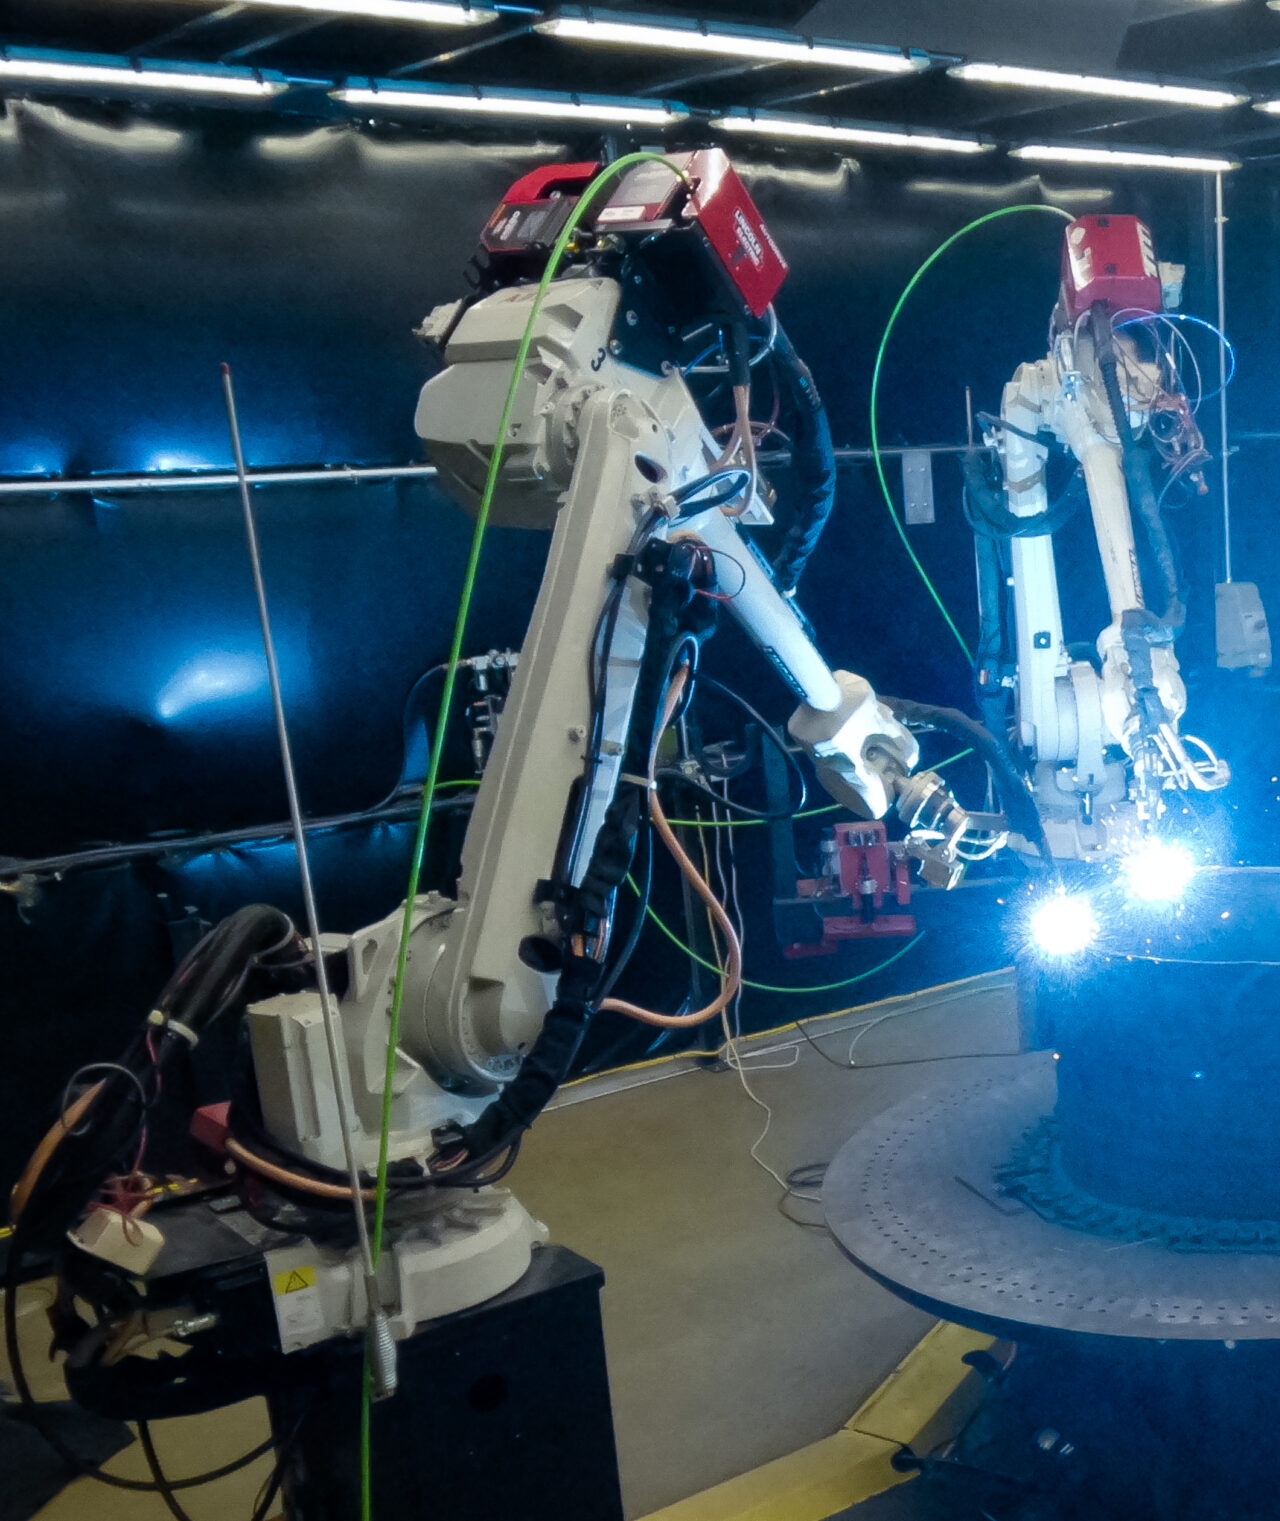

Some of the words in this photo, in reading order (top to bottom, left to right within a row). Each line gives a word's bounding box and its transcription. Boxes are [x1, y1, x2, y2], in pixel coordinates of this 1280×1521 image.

[734, 209, 761, 255] LINCOLN
[736, 226, 760, 266] ELECTRIC
[591, 347, 606, 372] 3
